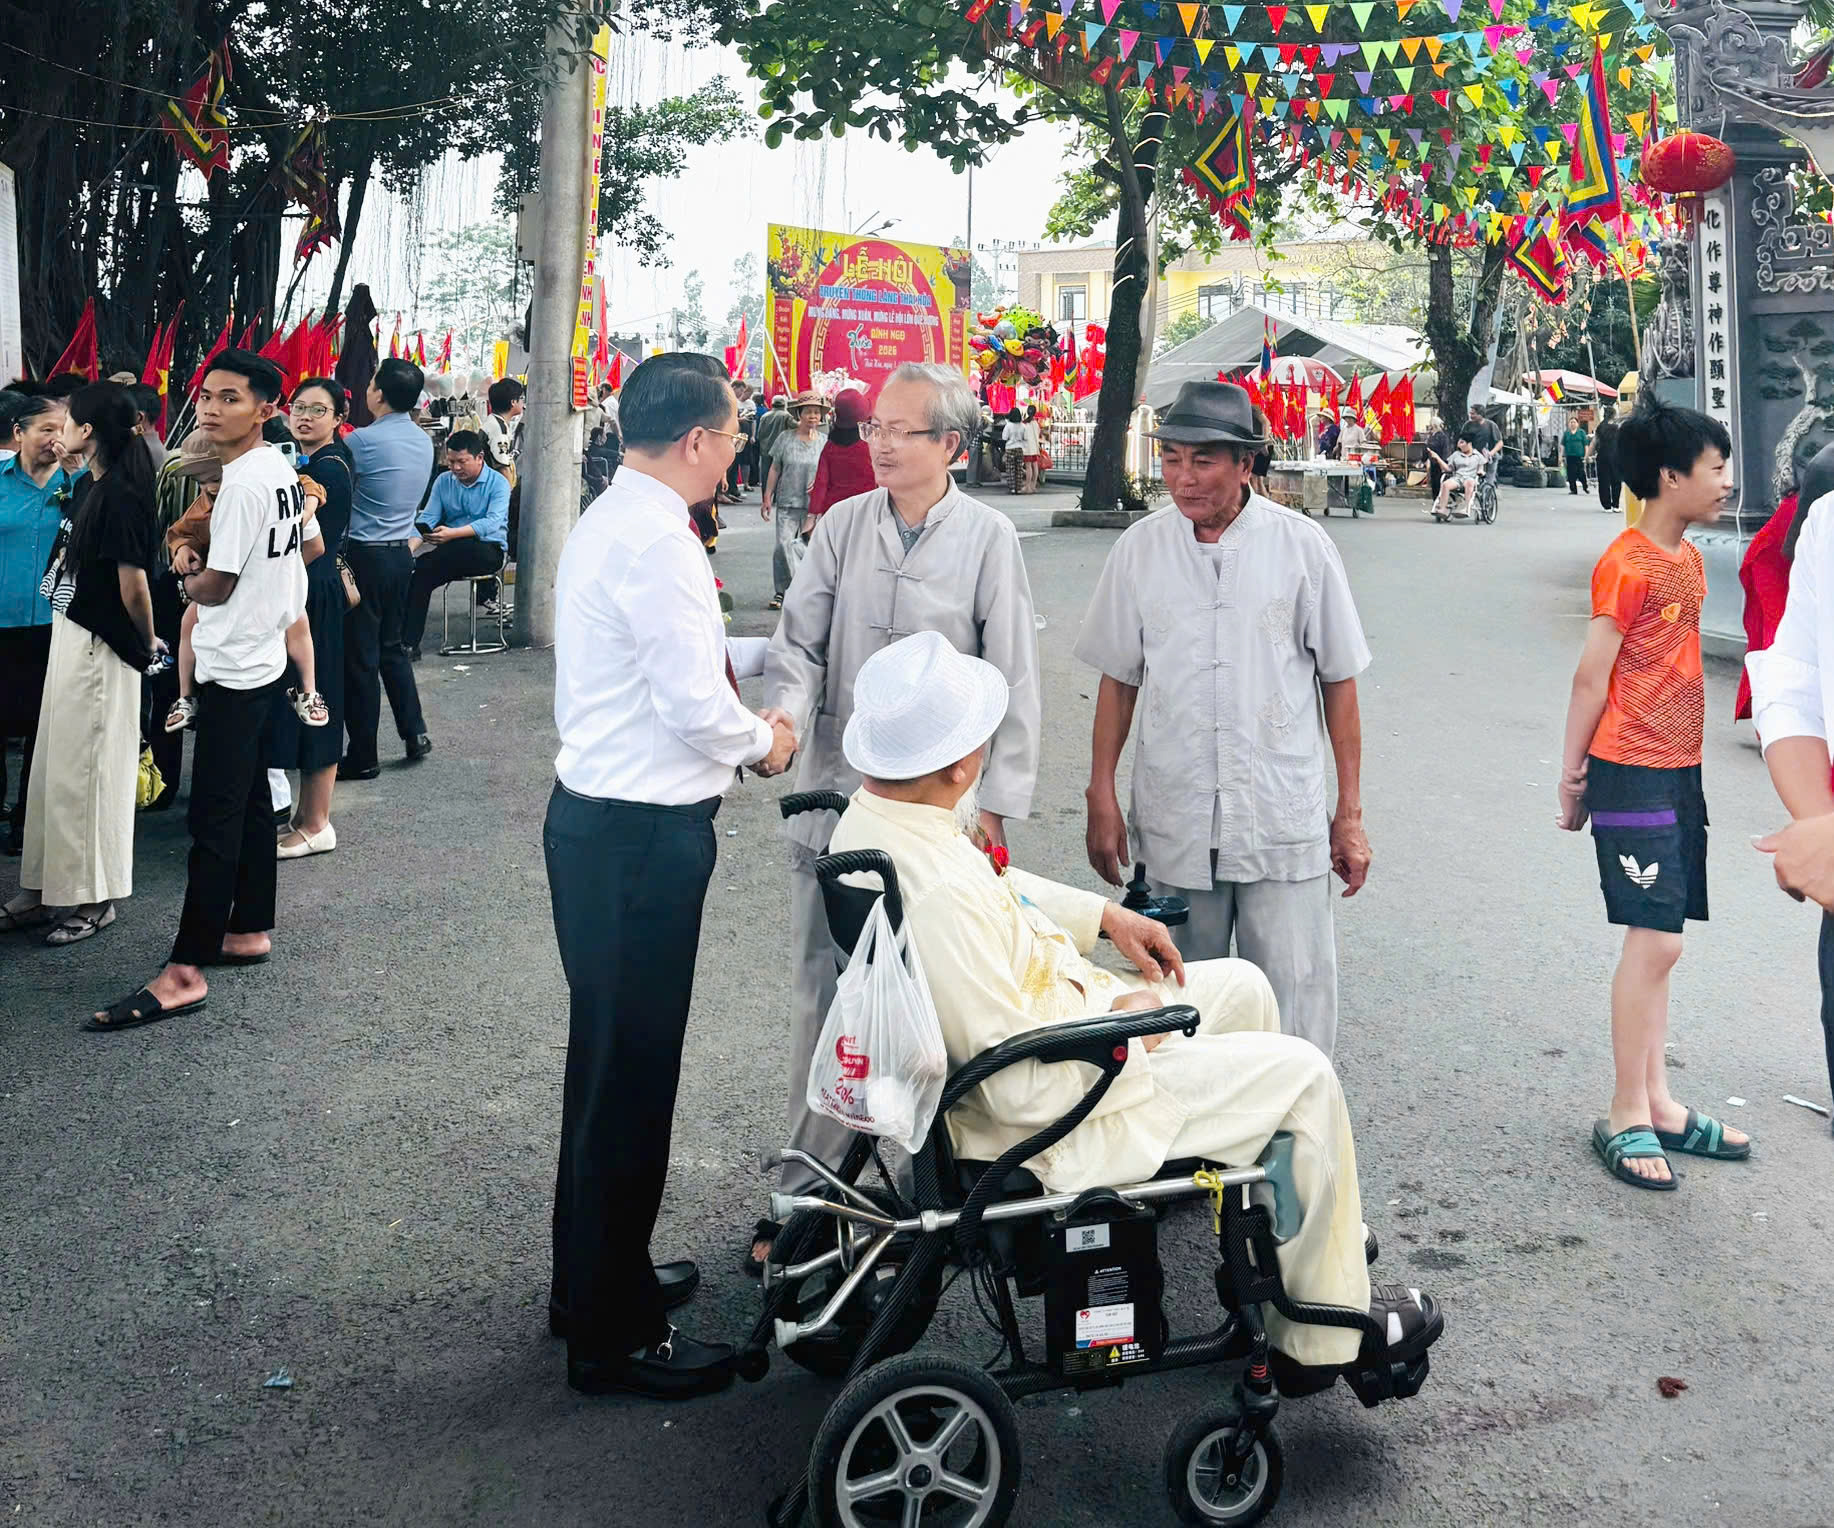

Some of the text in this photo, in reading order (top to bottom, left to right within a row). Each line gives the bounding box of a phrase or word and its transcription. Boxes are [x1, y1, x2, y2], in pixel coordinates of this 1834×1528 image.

[843, 246, 869, 279] LỄ
[851, 285, 877, 302] THỐNG
[878, 288, 898, 305] LÀNG
[878, 345, 897, 356] 2026
